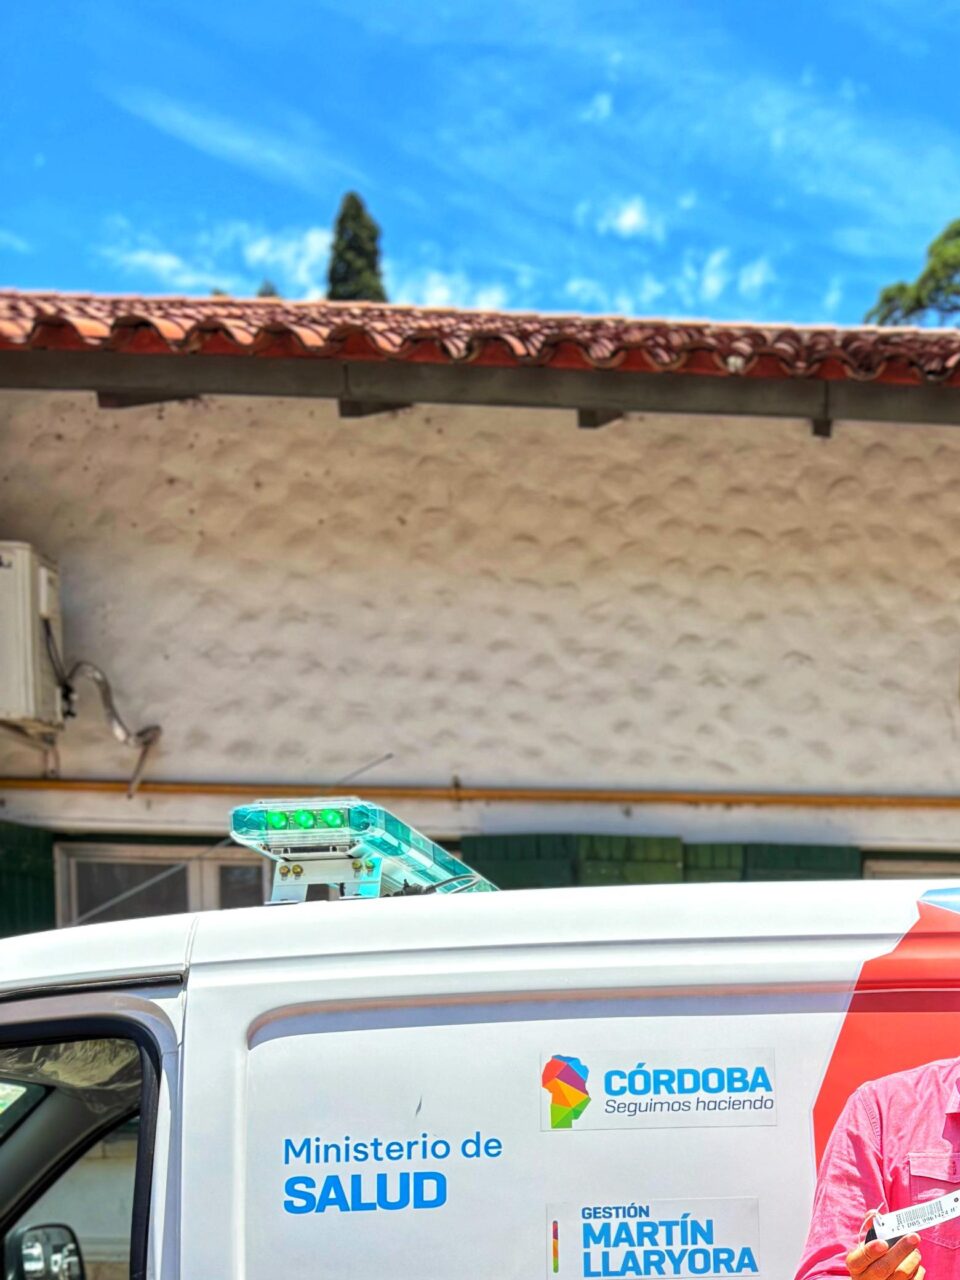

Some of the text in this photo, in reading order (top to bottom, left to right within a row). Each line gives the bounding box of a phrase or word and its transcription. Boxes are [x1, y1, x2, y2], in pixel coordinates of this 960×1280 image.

[603, 1063, 773, 1097] CÓRDOBA
[604, 1095, 774, 1116] Seguimos haciendo
[283, 1131, 503, 1165] Ministerio de
[283, 1171, 447, 1215] SALUD
[580, 1202, 650, 1220] GESTIÓN
[583, 1213, 714, 1249] MARTÍN
[583, 1247, 759, 1278] LLARYORA
